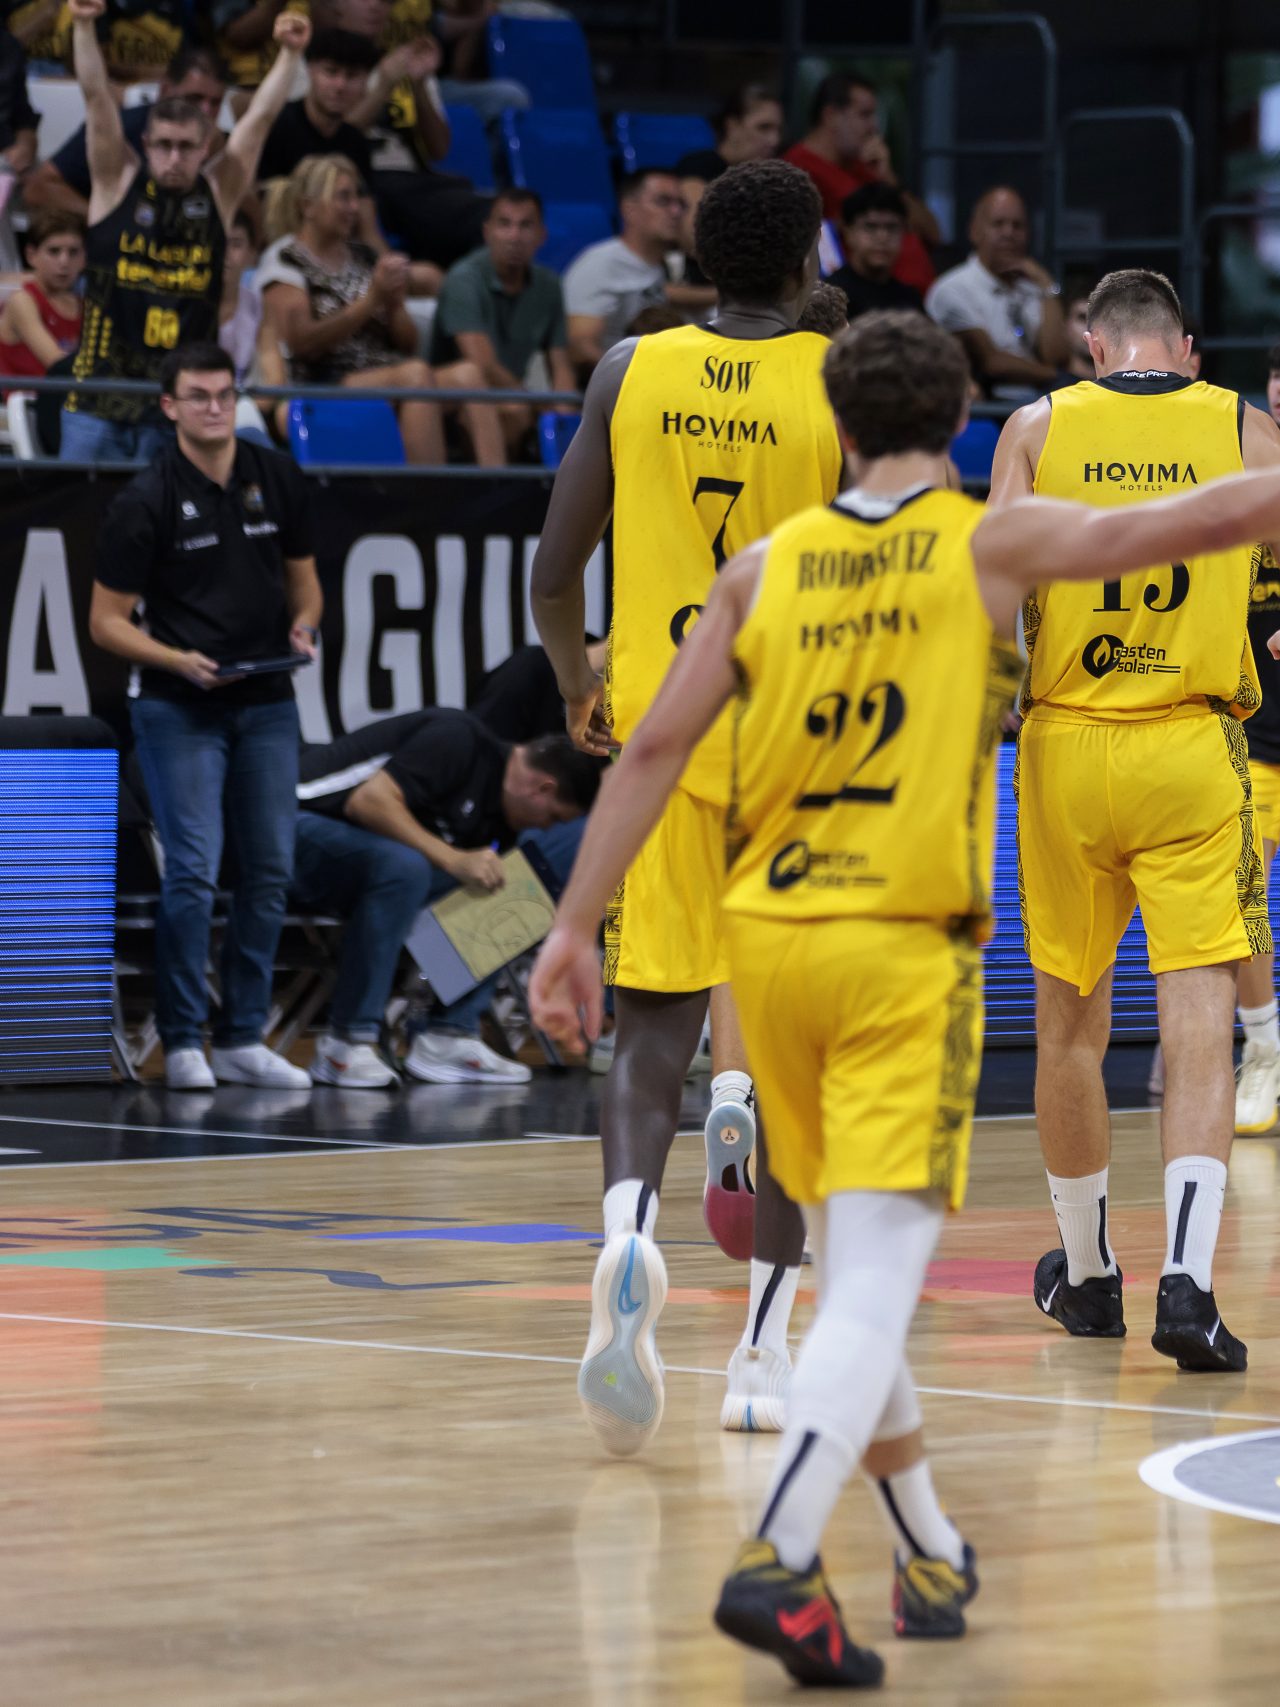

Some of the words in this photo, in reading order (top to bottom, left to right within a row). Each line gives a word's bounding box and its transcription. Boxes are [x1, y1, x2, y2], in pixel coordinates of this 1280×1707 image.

[700, 355, 760, 395] SOW
[662, 411, 778, 446] HOVIMA
[698, 441, 742, 453] HOTELS
[1084, 462, 1198, 484] HOVIMA
[692, 476, 745, 575] 7
[1117, 658, 1152, 674] solar
[795, 681, 908, 811] 22
